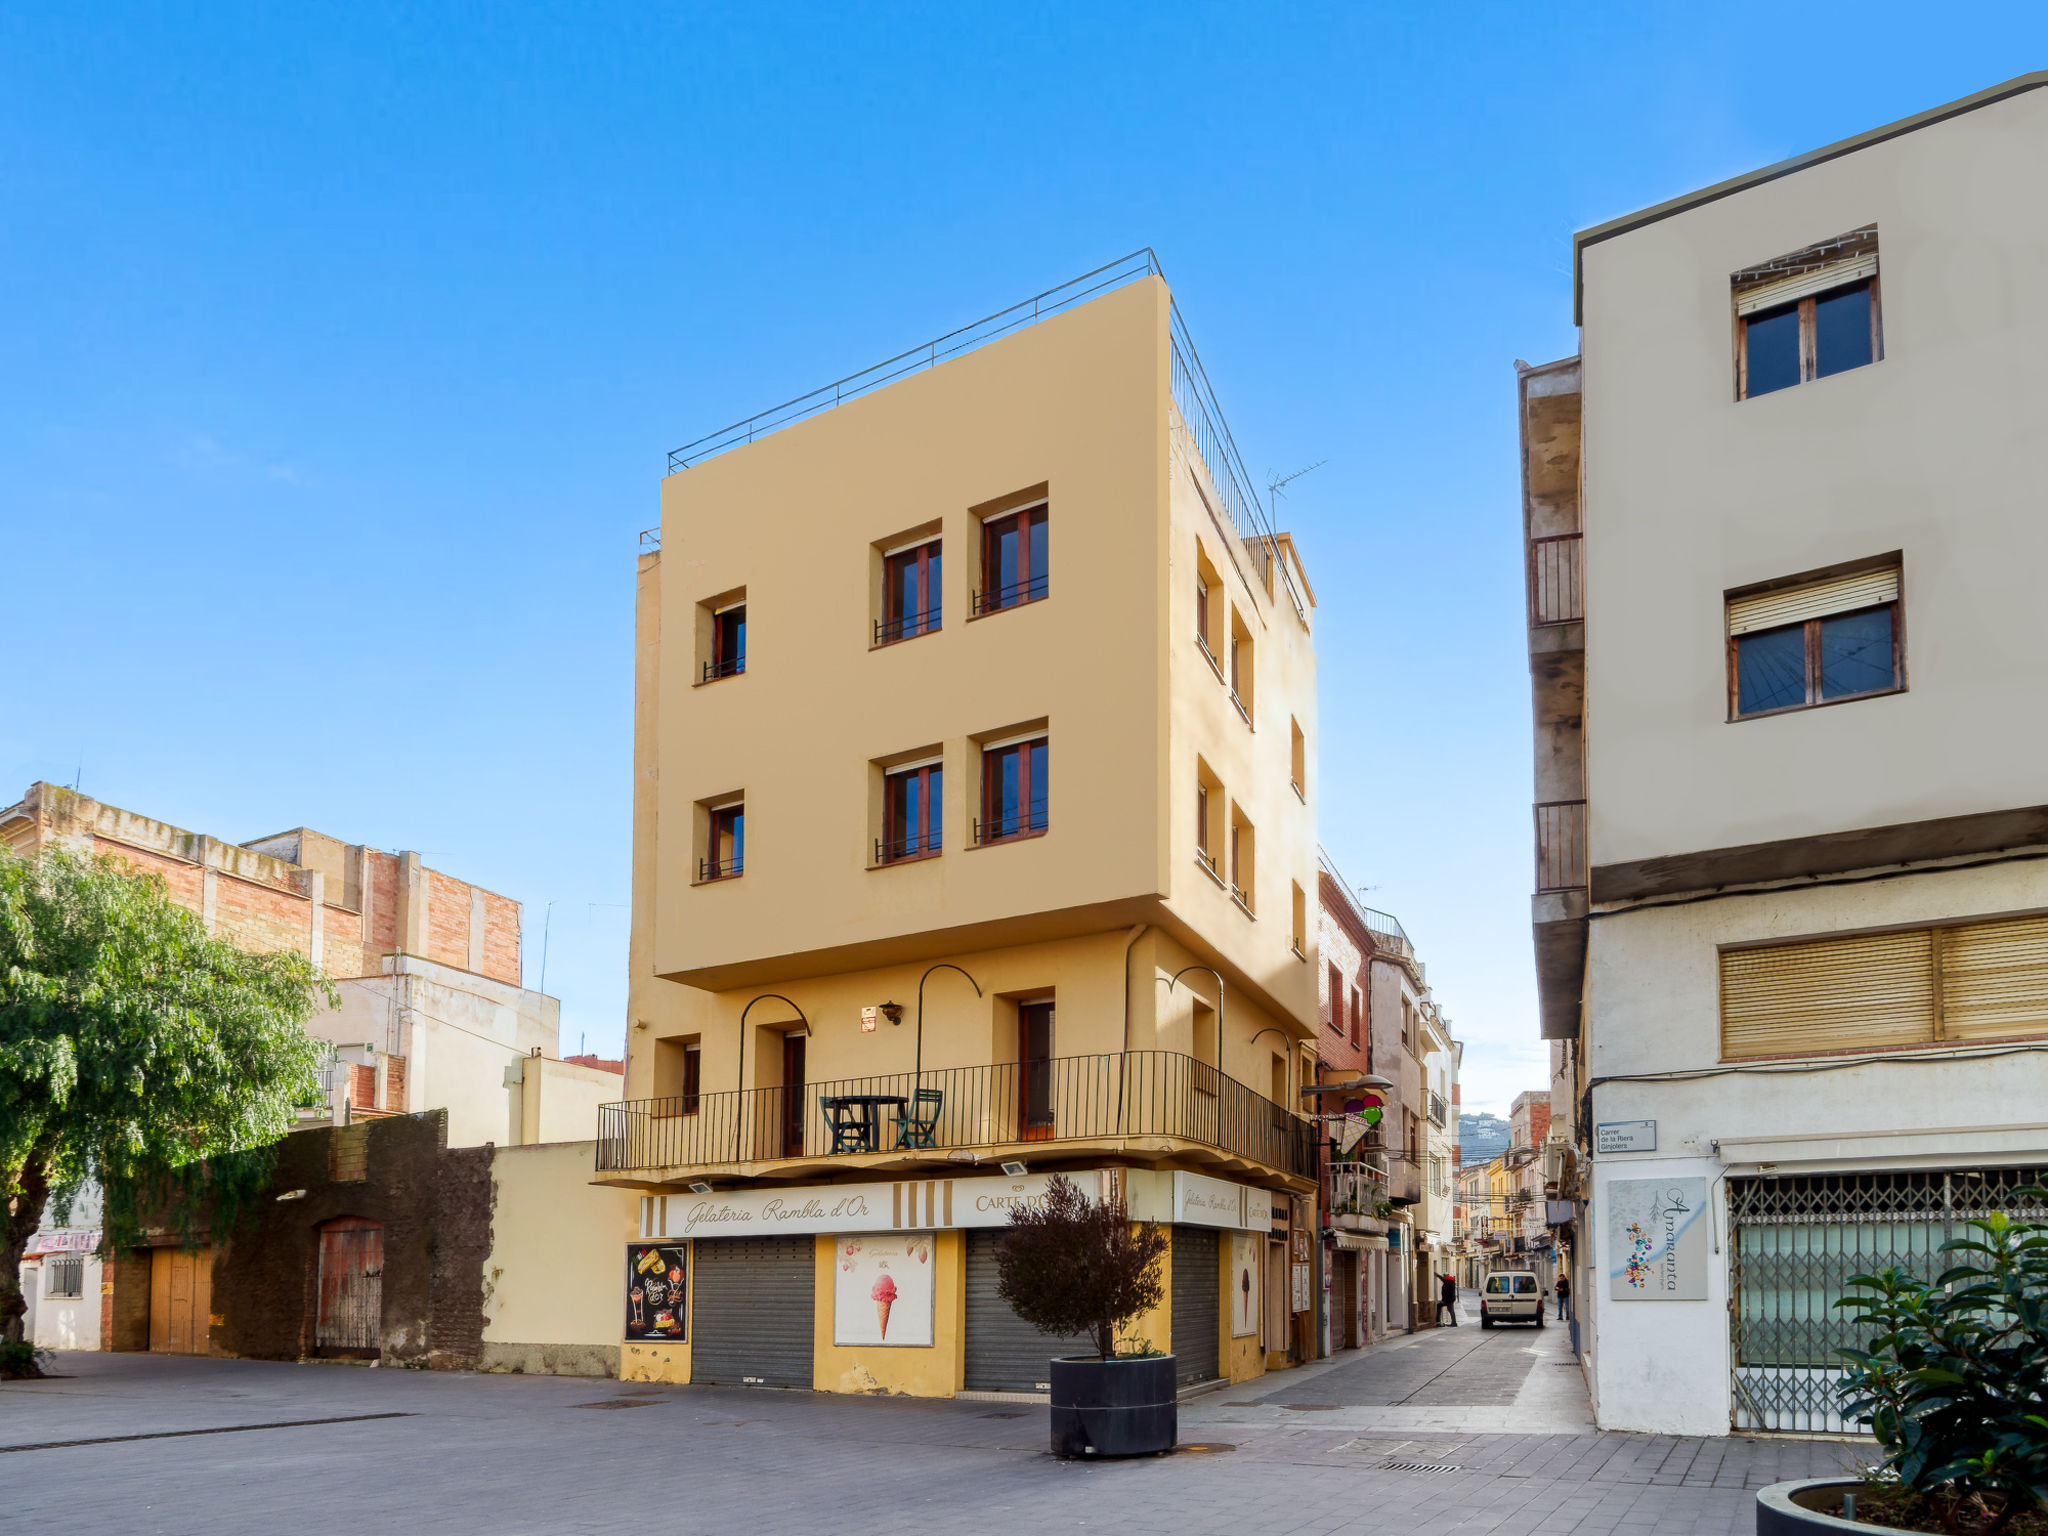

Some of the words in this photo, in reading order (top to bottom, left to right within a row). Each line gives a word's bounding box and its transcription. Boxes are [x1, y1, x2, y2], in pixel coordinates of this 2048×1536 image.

[684, 1201, 752, 1233] Gelateria
[761, 1198, 826, 1222] Rambla
[830, 1195, 870, 1218] d'Or
[1663, 1187, 1691, 1291] Amaranta
